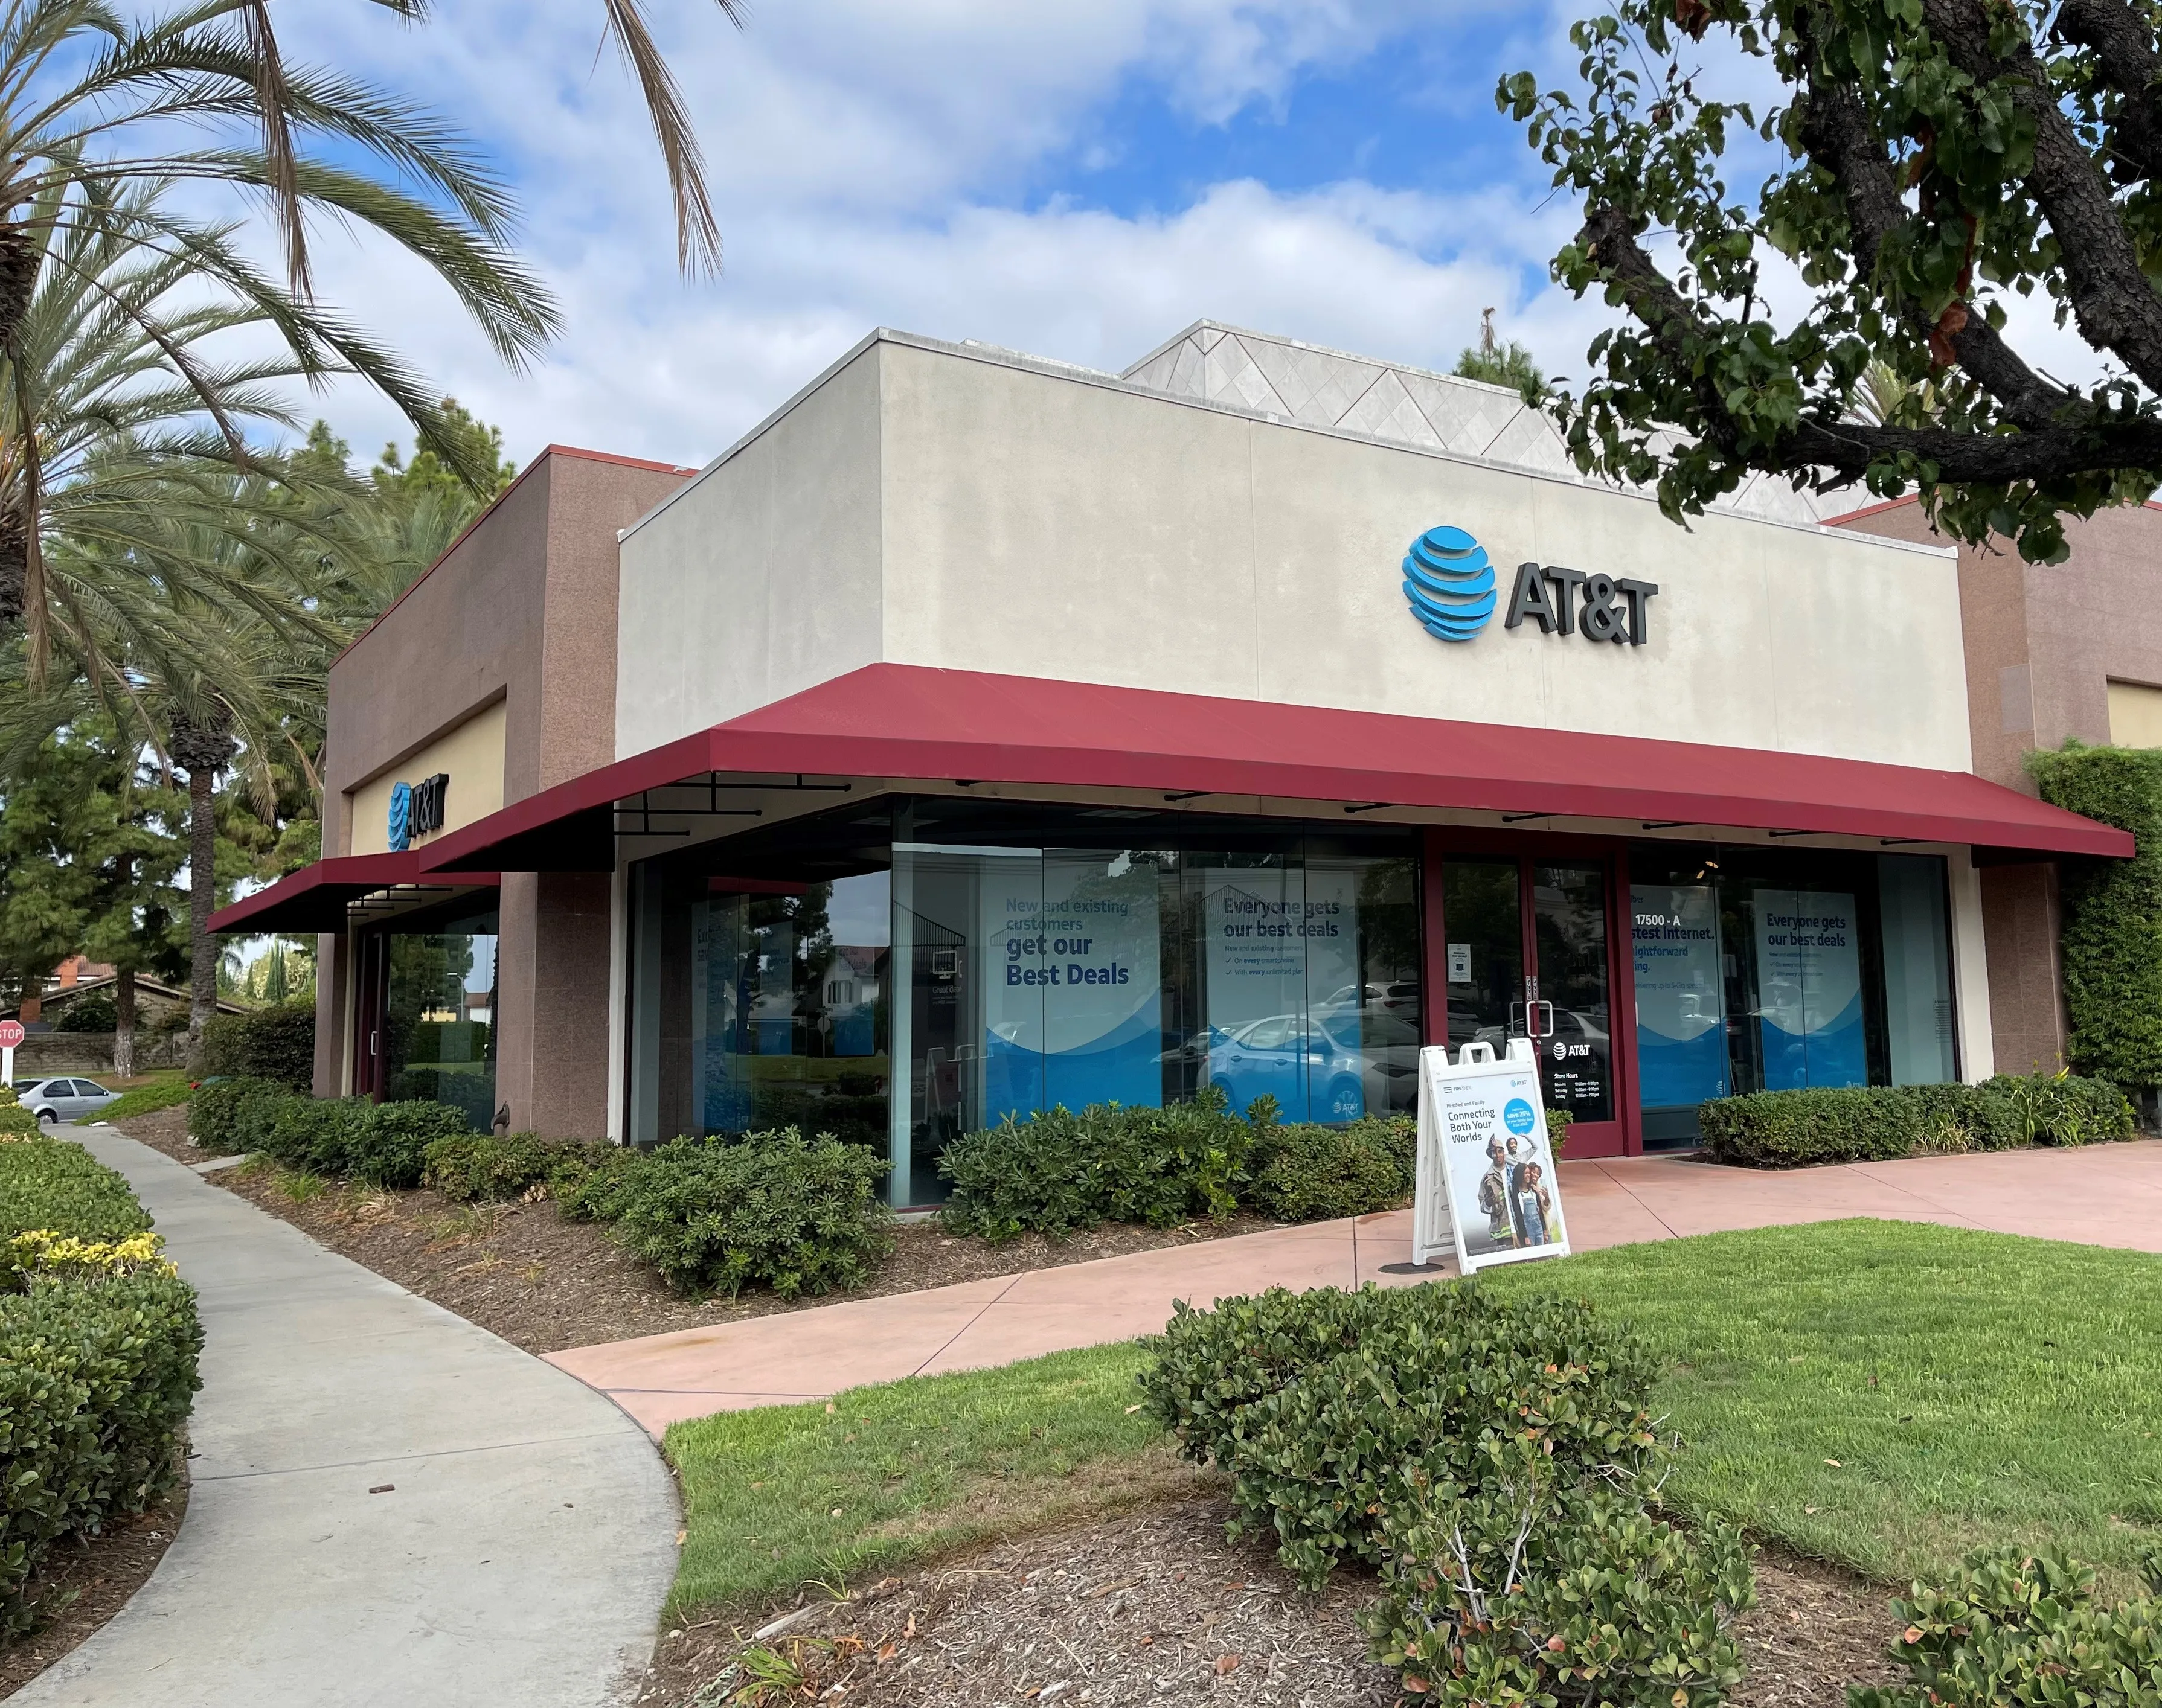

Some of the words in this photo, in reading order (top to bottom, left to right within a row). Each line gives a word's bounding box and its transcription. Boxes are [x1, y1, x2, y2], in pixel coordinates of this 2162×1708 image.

[1504, 562, 1658, 646] AT&T
[406, 773, 449, 838] AT&T
[1006, 898, 1039, 912] New
[1044, 900, 1069, 912] and
[1073, 899, 1129, 916] existing
[1224, 897, 1301, 919] Everyone
[1305, 900, 1339, 919] gets
[1006, 919, 1083, 930] customers
[1635, 914, 1664, 926] 17500
[1673, 915, 1681, 926] A
[1766, 913, 1819, 931] Everyone
[1821, 916, 1846, 932] gets
[1224, 924, 1253, 937] our
[1257, 920, 1293, 937] best
[1297, 920, 1338, 937] deals
[1663, 926, 1715, 940] Internet.
[1768, 935, 1787, 946] our
[1790, 932, 1815, 946] best
[1817, 933, 1846, 947] deals
[1007, 935, 1048, 962] get
[1053, 938, 1093, 955] our
[1633, 945, 1688, 958] ightforward
[1007, 964, 1061, 986] Best
[1067, 962, 1129, 985] Deals
[1568, 1044, 1591, 1057] AT&T
[1448, 1108, 1496, 1121] Connecting
[1450, 1121, 1472, 1133] Both
[1472, 1120, 1492, 1129] Your
[1451, 1131, 1483, 1144] Worlds
